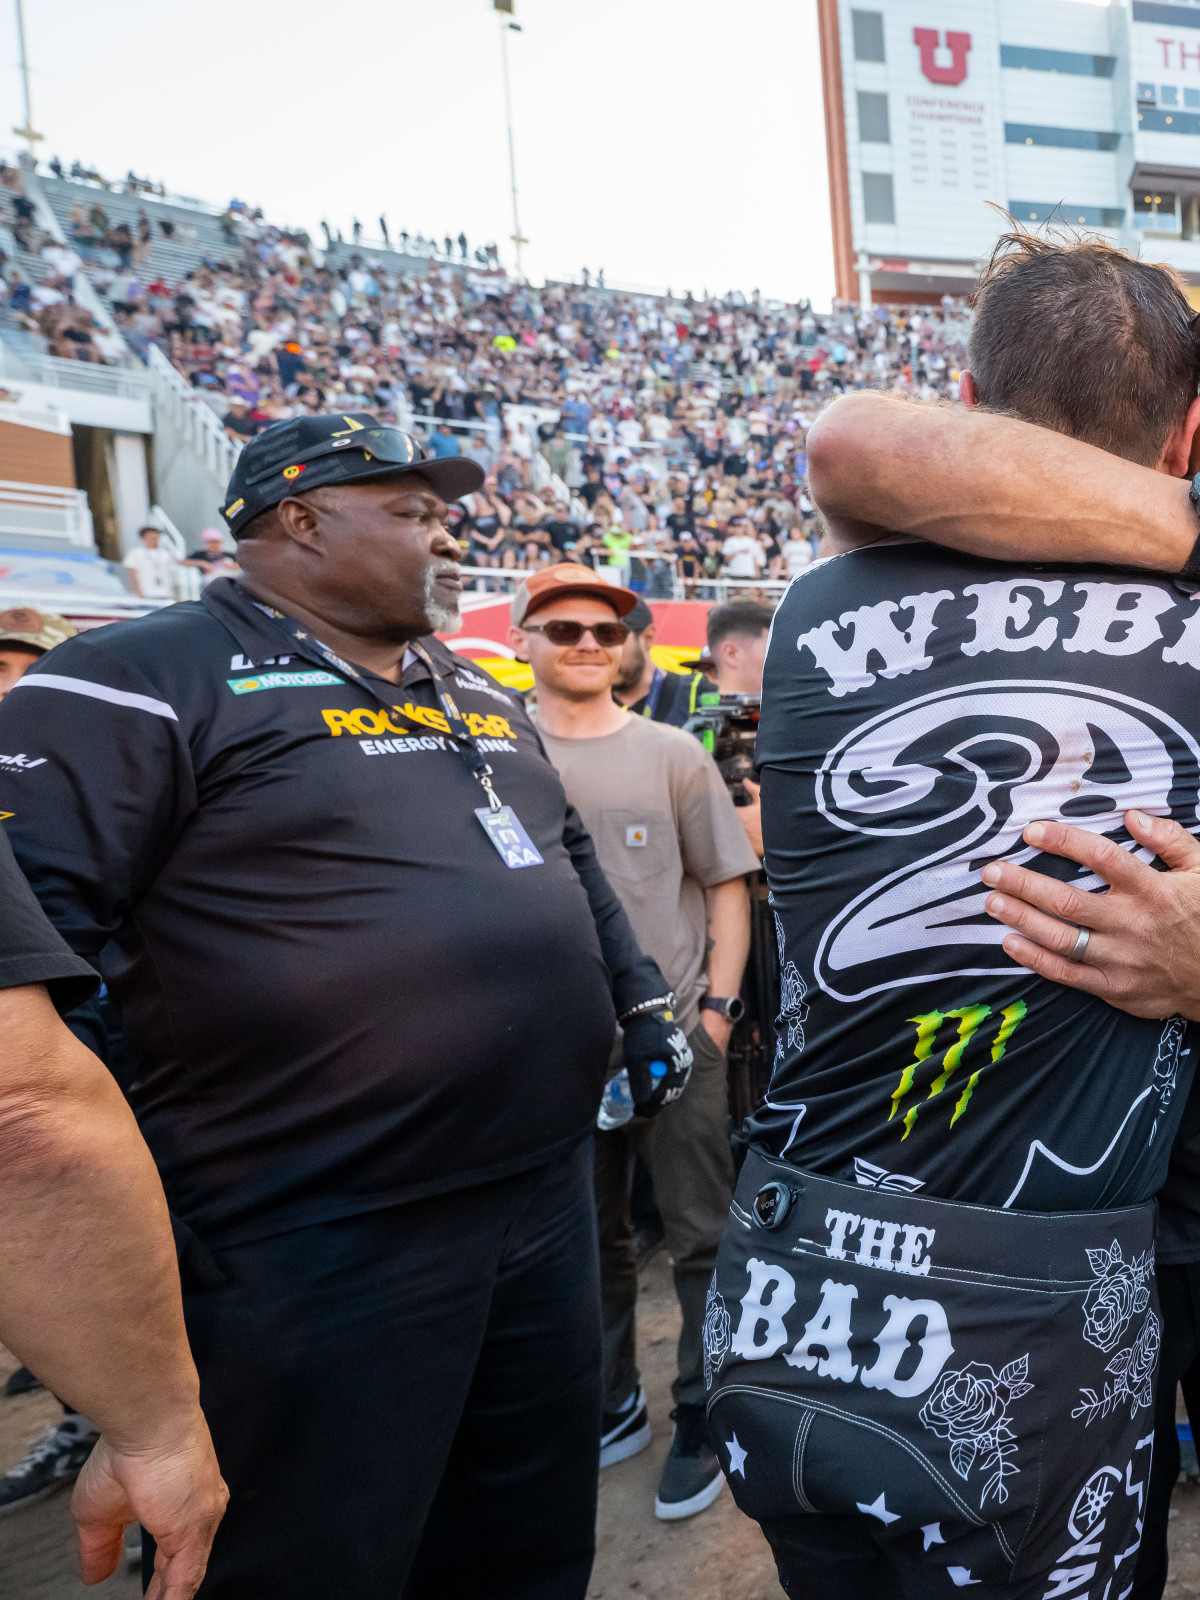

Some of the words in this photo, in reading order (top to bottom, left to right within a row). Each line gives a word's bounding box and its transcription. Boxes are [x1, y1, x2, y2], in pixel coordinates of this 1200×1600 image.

[912, 27, 972, 86] U
[258, 671, 341, 687] MOTOREX
[359, 736, 448, 756] ENERGY
[825, 1207, 936, 1277] THE
[731, 1257, 955, 1398] BAD
